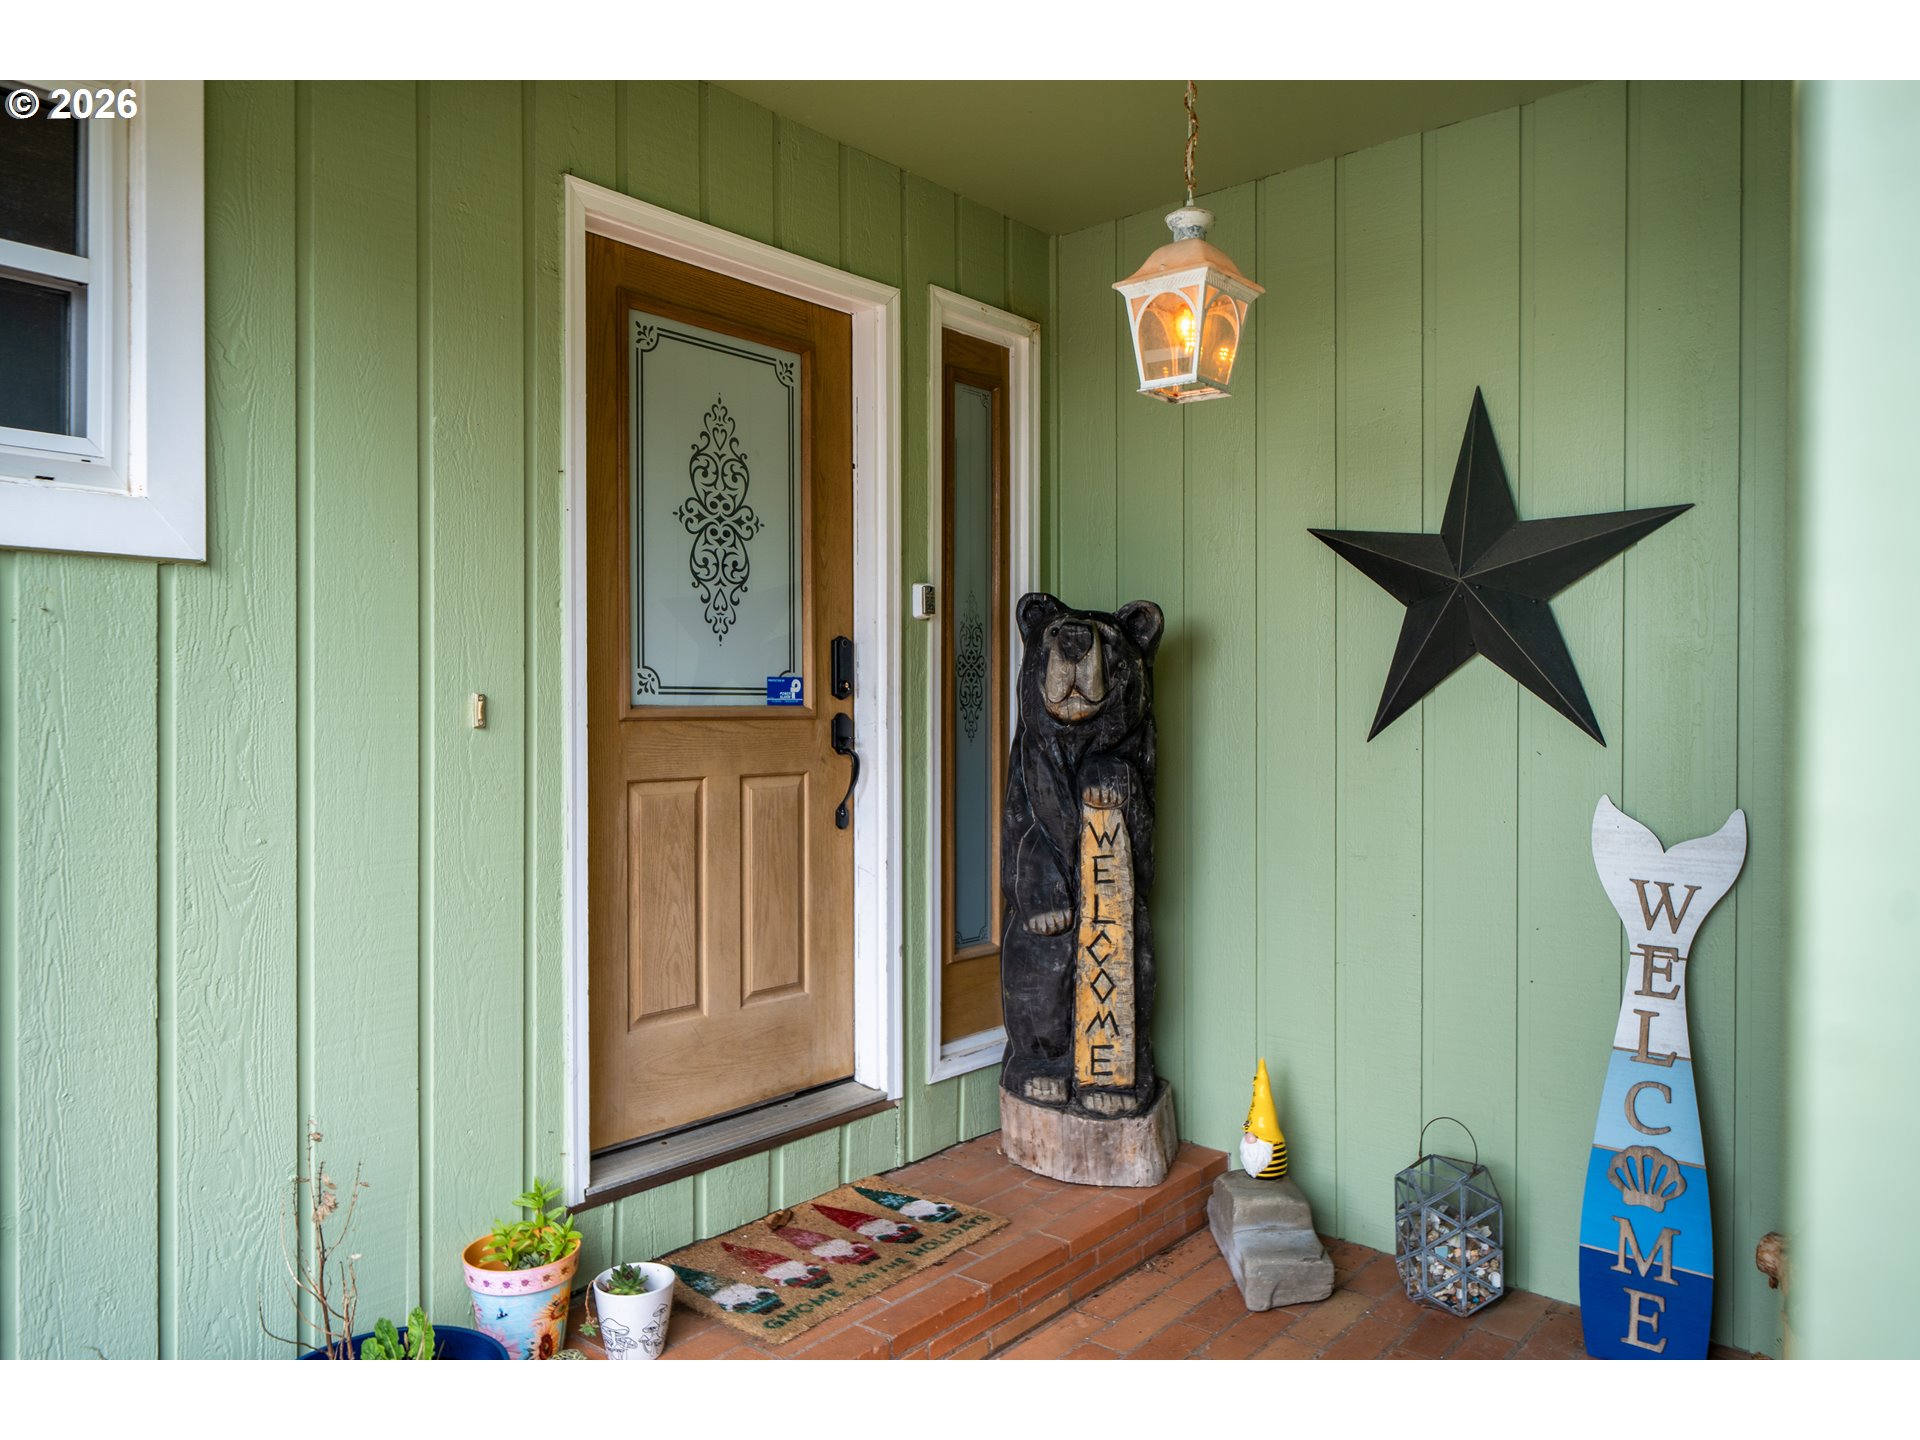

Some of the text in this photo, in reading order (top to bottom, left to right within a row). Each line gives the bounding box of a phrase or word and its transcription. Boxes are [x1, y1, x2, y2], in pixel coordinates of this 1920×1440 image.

[1085, 821, 1121, 1076] WELCOME
[1609, 877, 1702, 1354] WELCME
[762, 1214, 991, 1329] GNOME FOR THE HOLIDAYS
